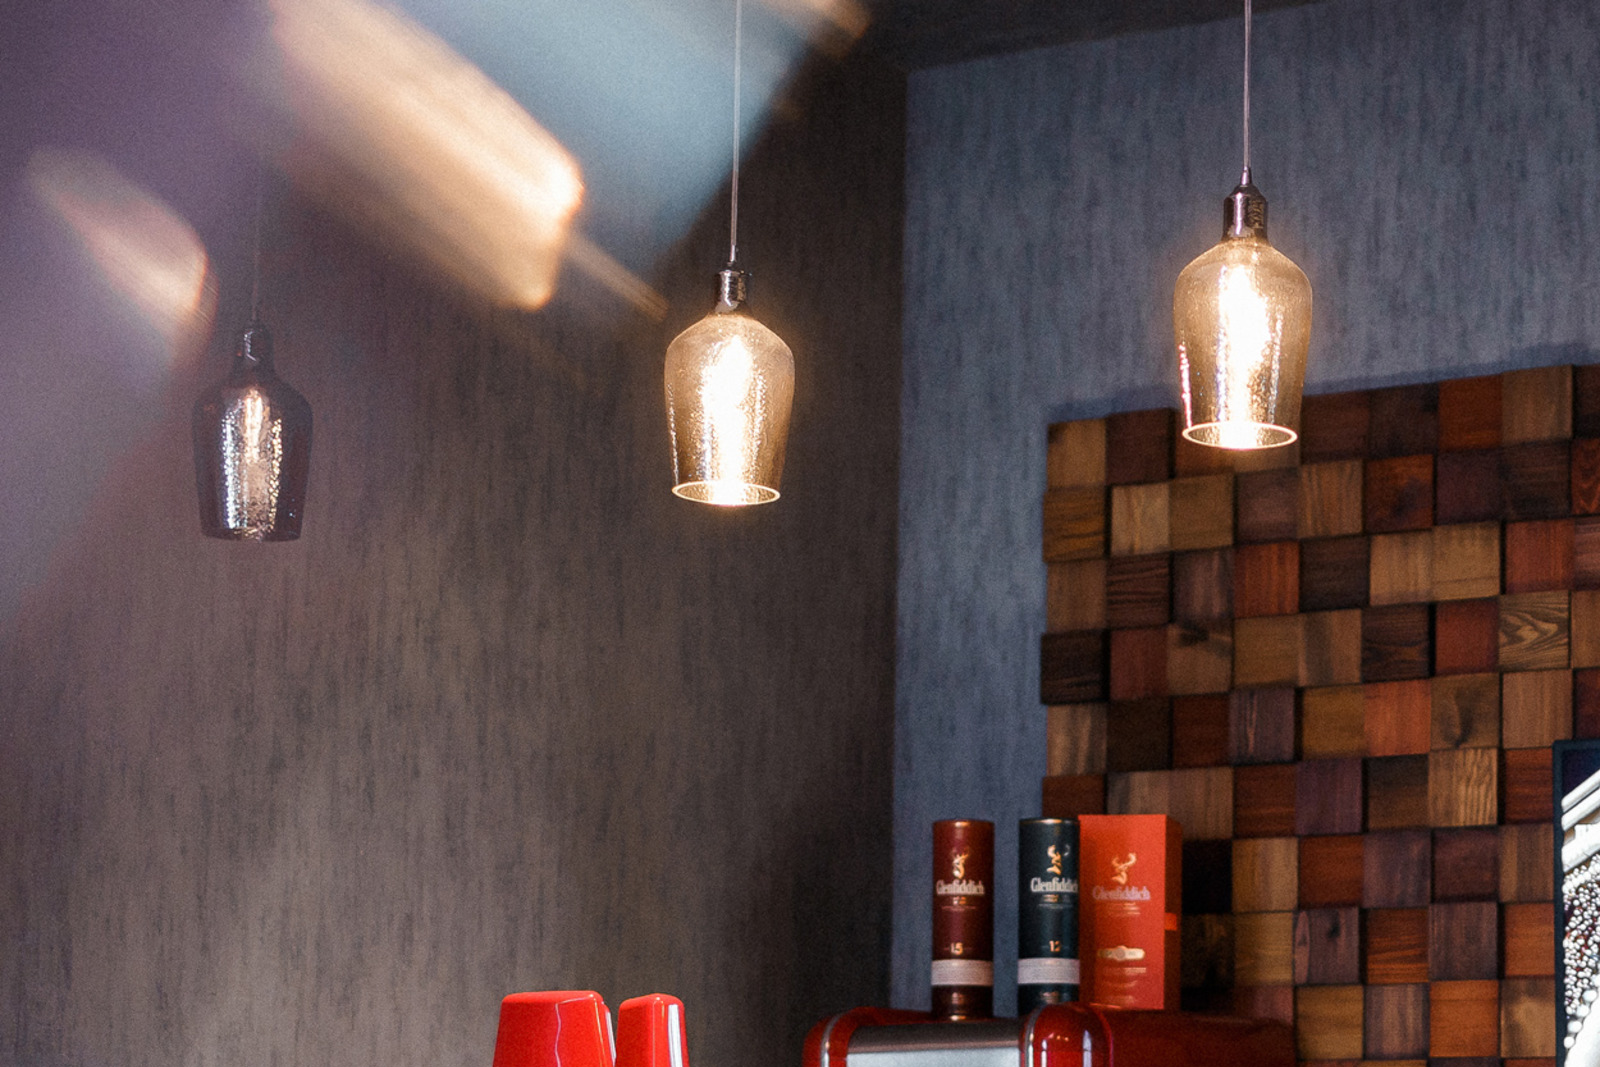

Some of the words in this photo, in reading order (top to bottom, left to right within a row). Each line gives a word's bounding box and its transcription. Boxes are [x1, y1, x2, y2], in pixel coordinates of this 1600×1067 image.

[936, 879, 985, 895] Glenfiddich
[1093, 885, 1151, 900] Glenfiddich
[951, 942, 963, 955] 15
[1049, 940, 1061, 952] 12
